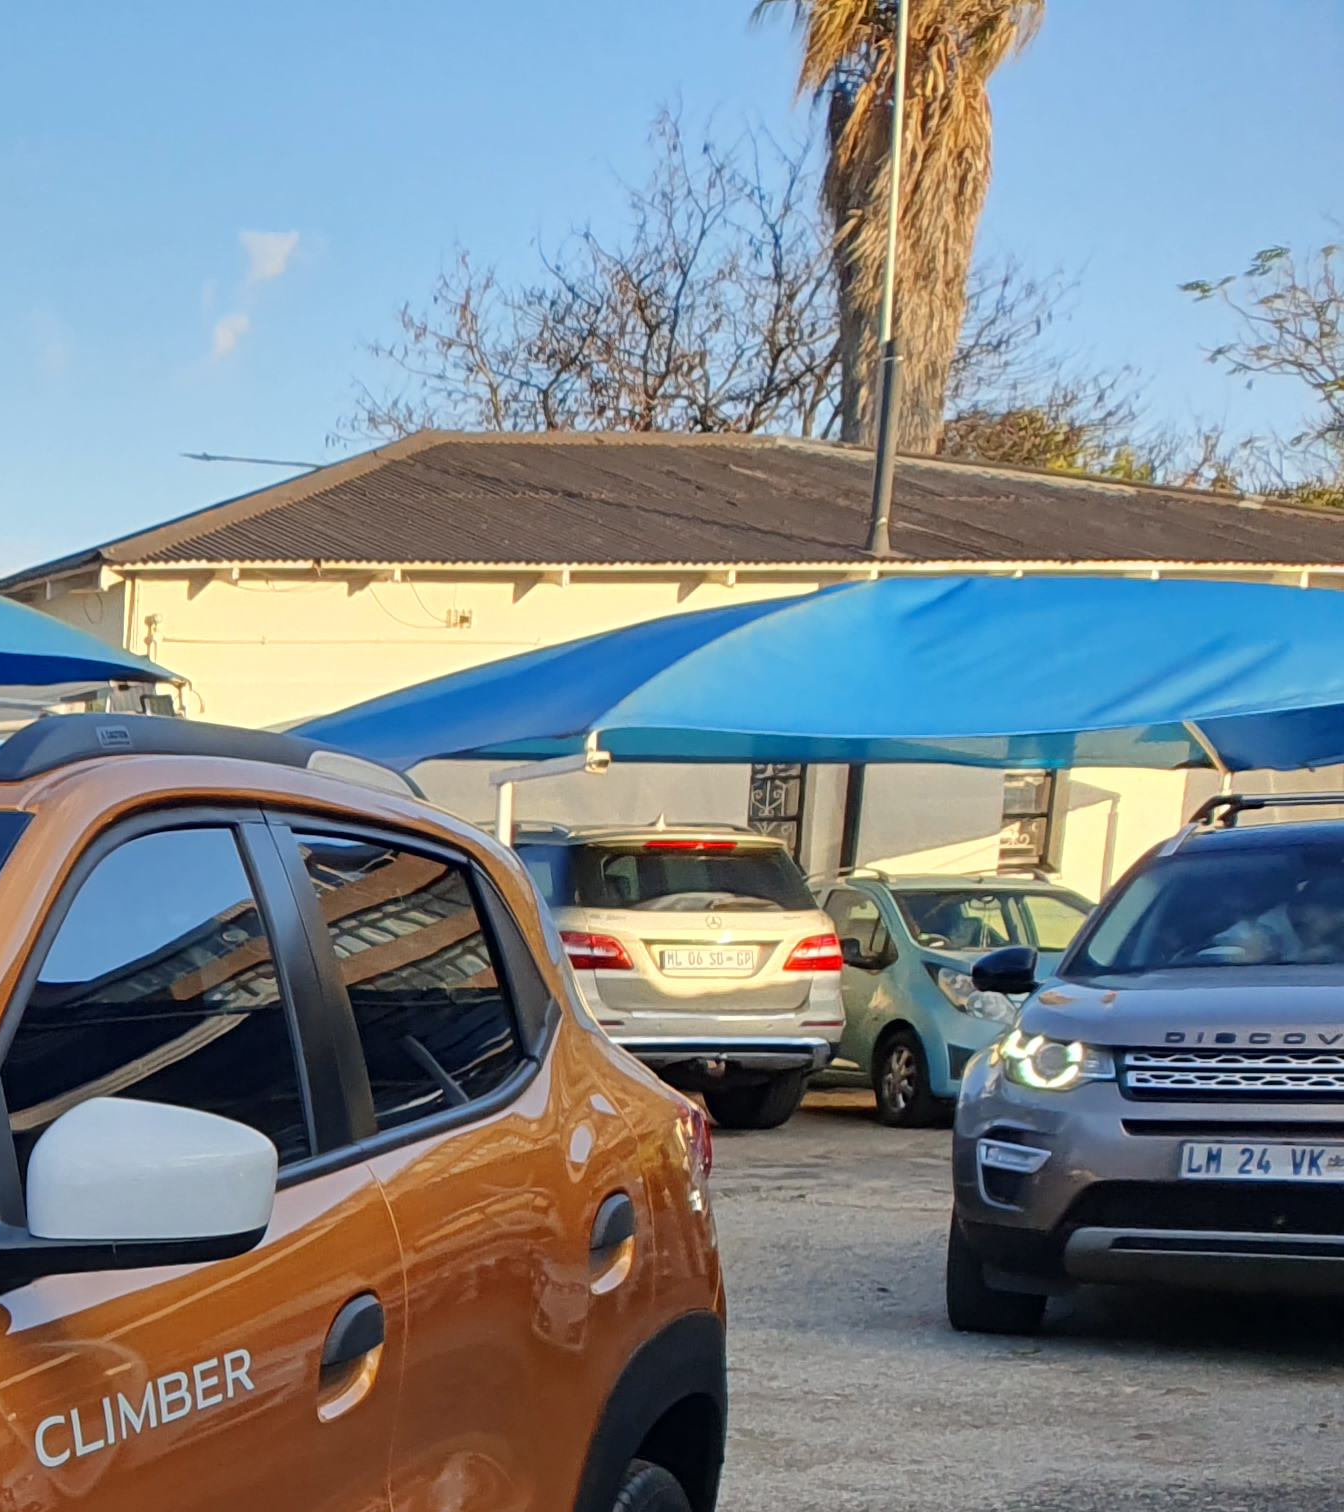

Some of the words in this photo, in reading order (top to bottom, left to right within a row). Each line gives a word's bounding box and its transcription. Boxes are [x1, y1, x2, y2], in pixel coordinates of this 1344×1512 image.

[1187, 1146, 1223, 1174] LM
[1237, 1147, 1271, 1175] 24
[1291, 1148, 1326, 1176] VK
[34, 1348, 255, 1468] CLIMBER
